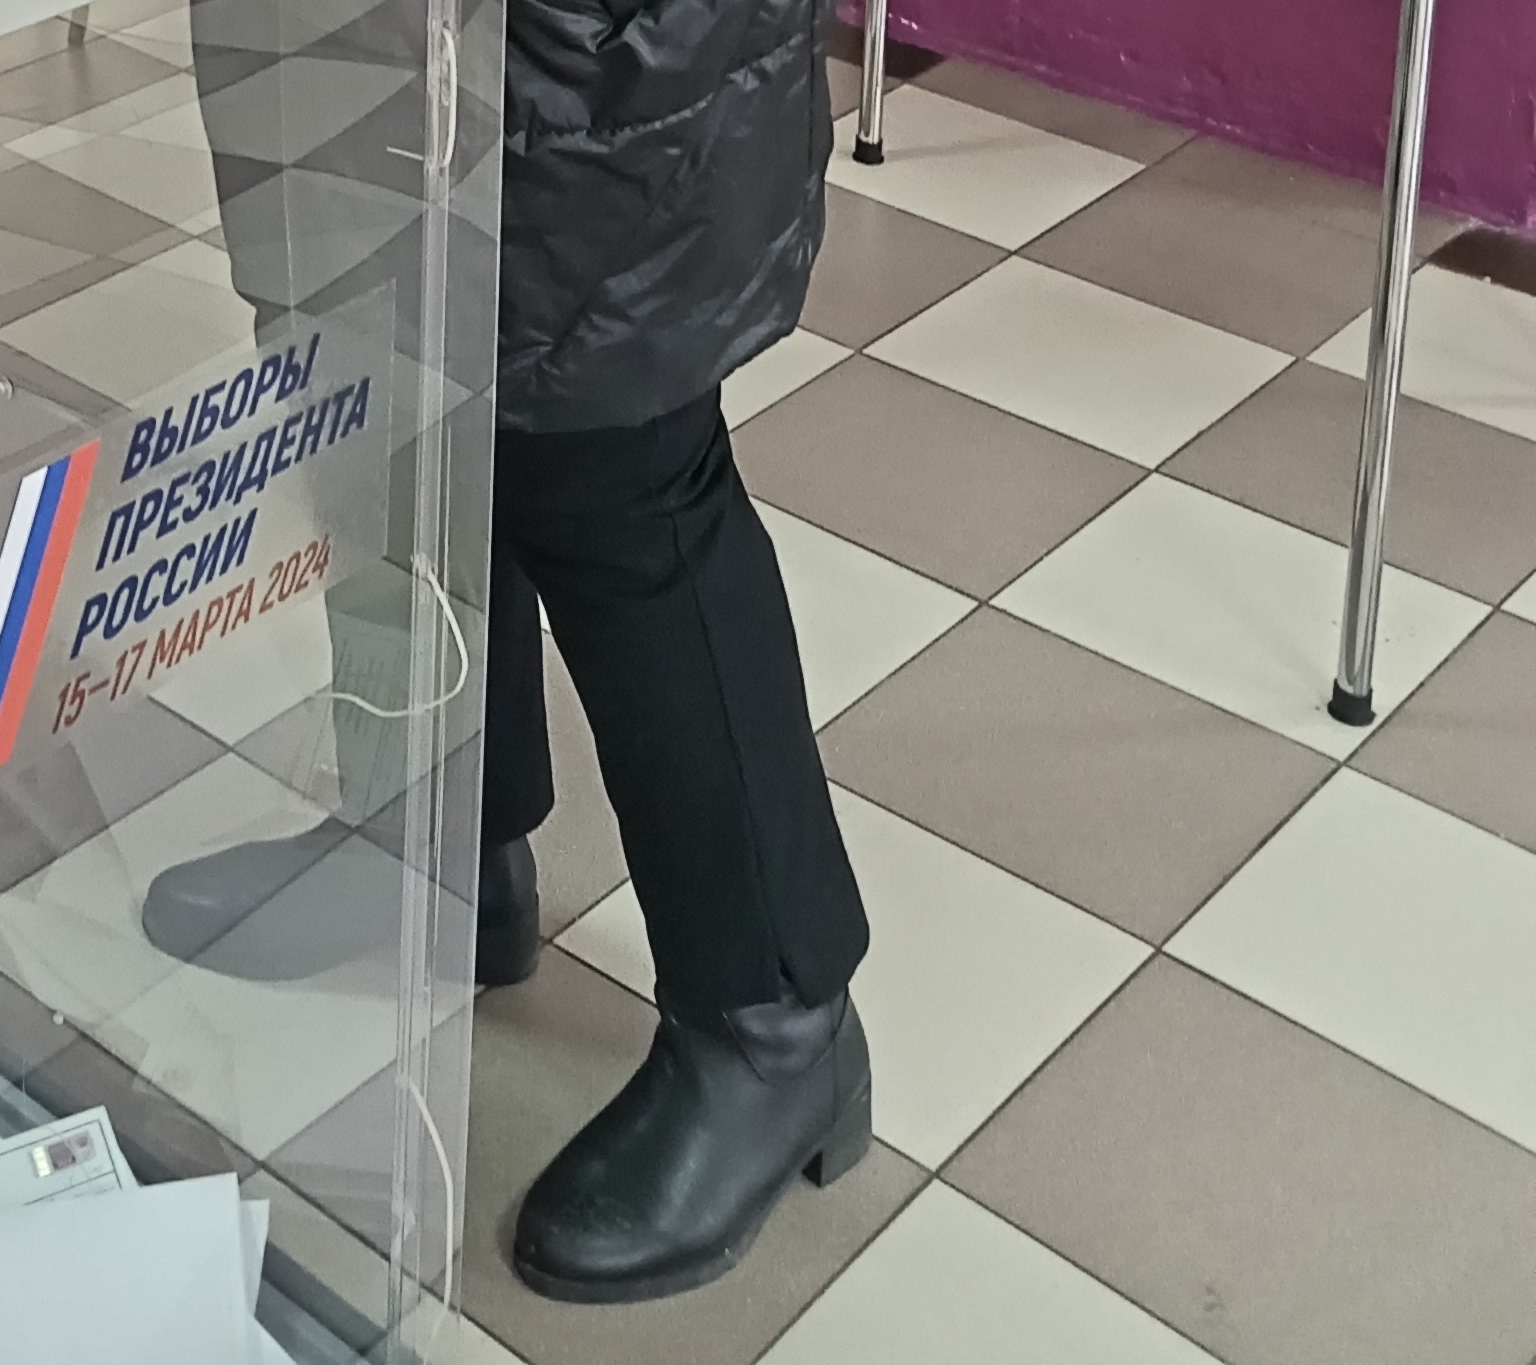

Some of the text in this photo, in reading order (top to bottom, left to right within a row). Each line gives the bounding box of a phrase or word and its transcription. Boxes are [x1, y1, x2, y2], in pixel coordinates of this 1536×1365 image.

[94, 376, 371, 572] ПРЕЗИДЕНТА
[120, 332, 321, 484] ВЫБОРЫ
[70, 507, 259, 660] РОССИИ
[147, 577, 256, 680] МАРТА
[259, 533, 332, 615] 2024
